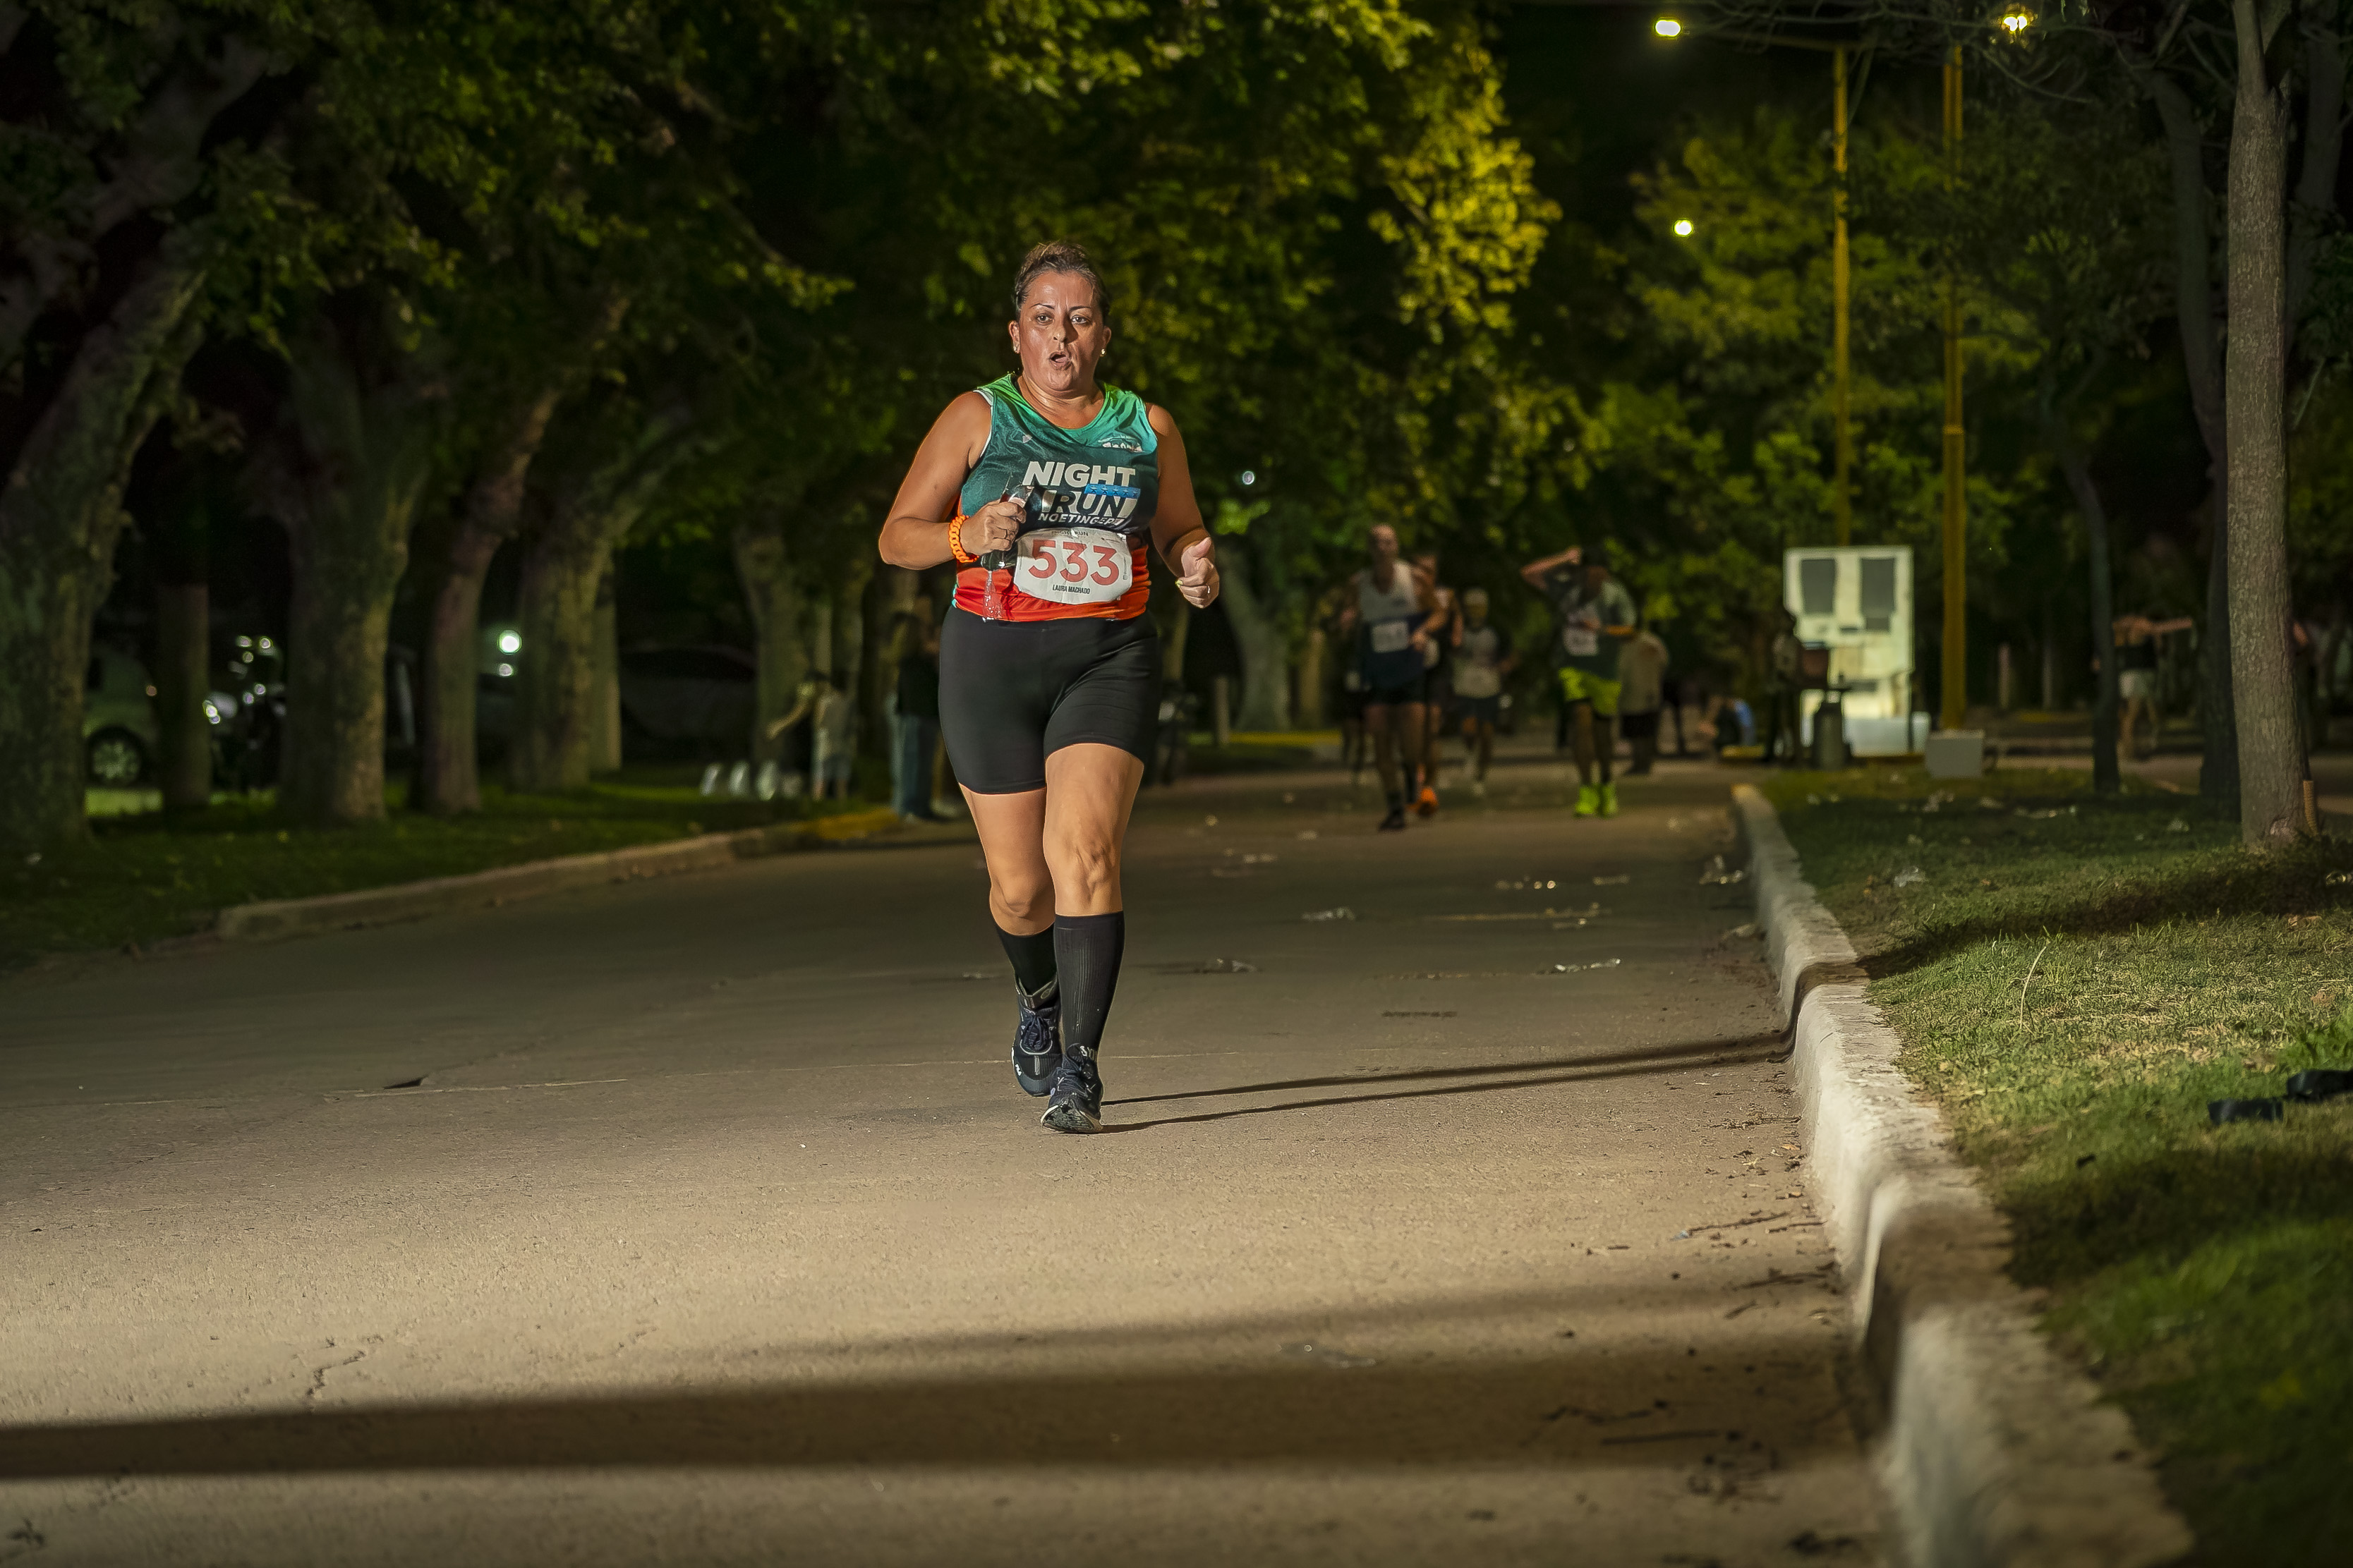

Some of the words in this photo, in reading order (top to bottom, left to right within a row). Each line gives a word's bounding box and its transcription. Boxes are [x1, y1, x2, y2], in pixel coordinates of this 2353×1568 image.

[1022, 461, 1136, 488] NIGHT
[1043, 490, 1134, 518] RUN
[1028, 540, 1120, 586] 533
[1052, 584, 1067, 592] LAURA
[1067, 585, 1091, 595] MACHADO
